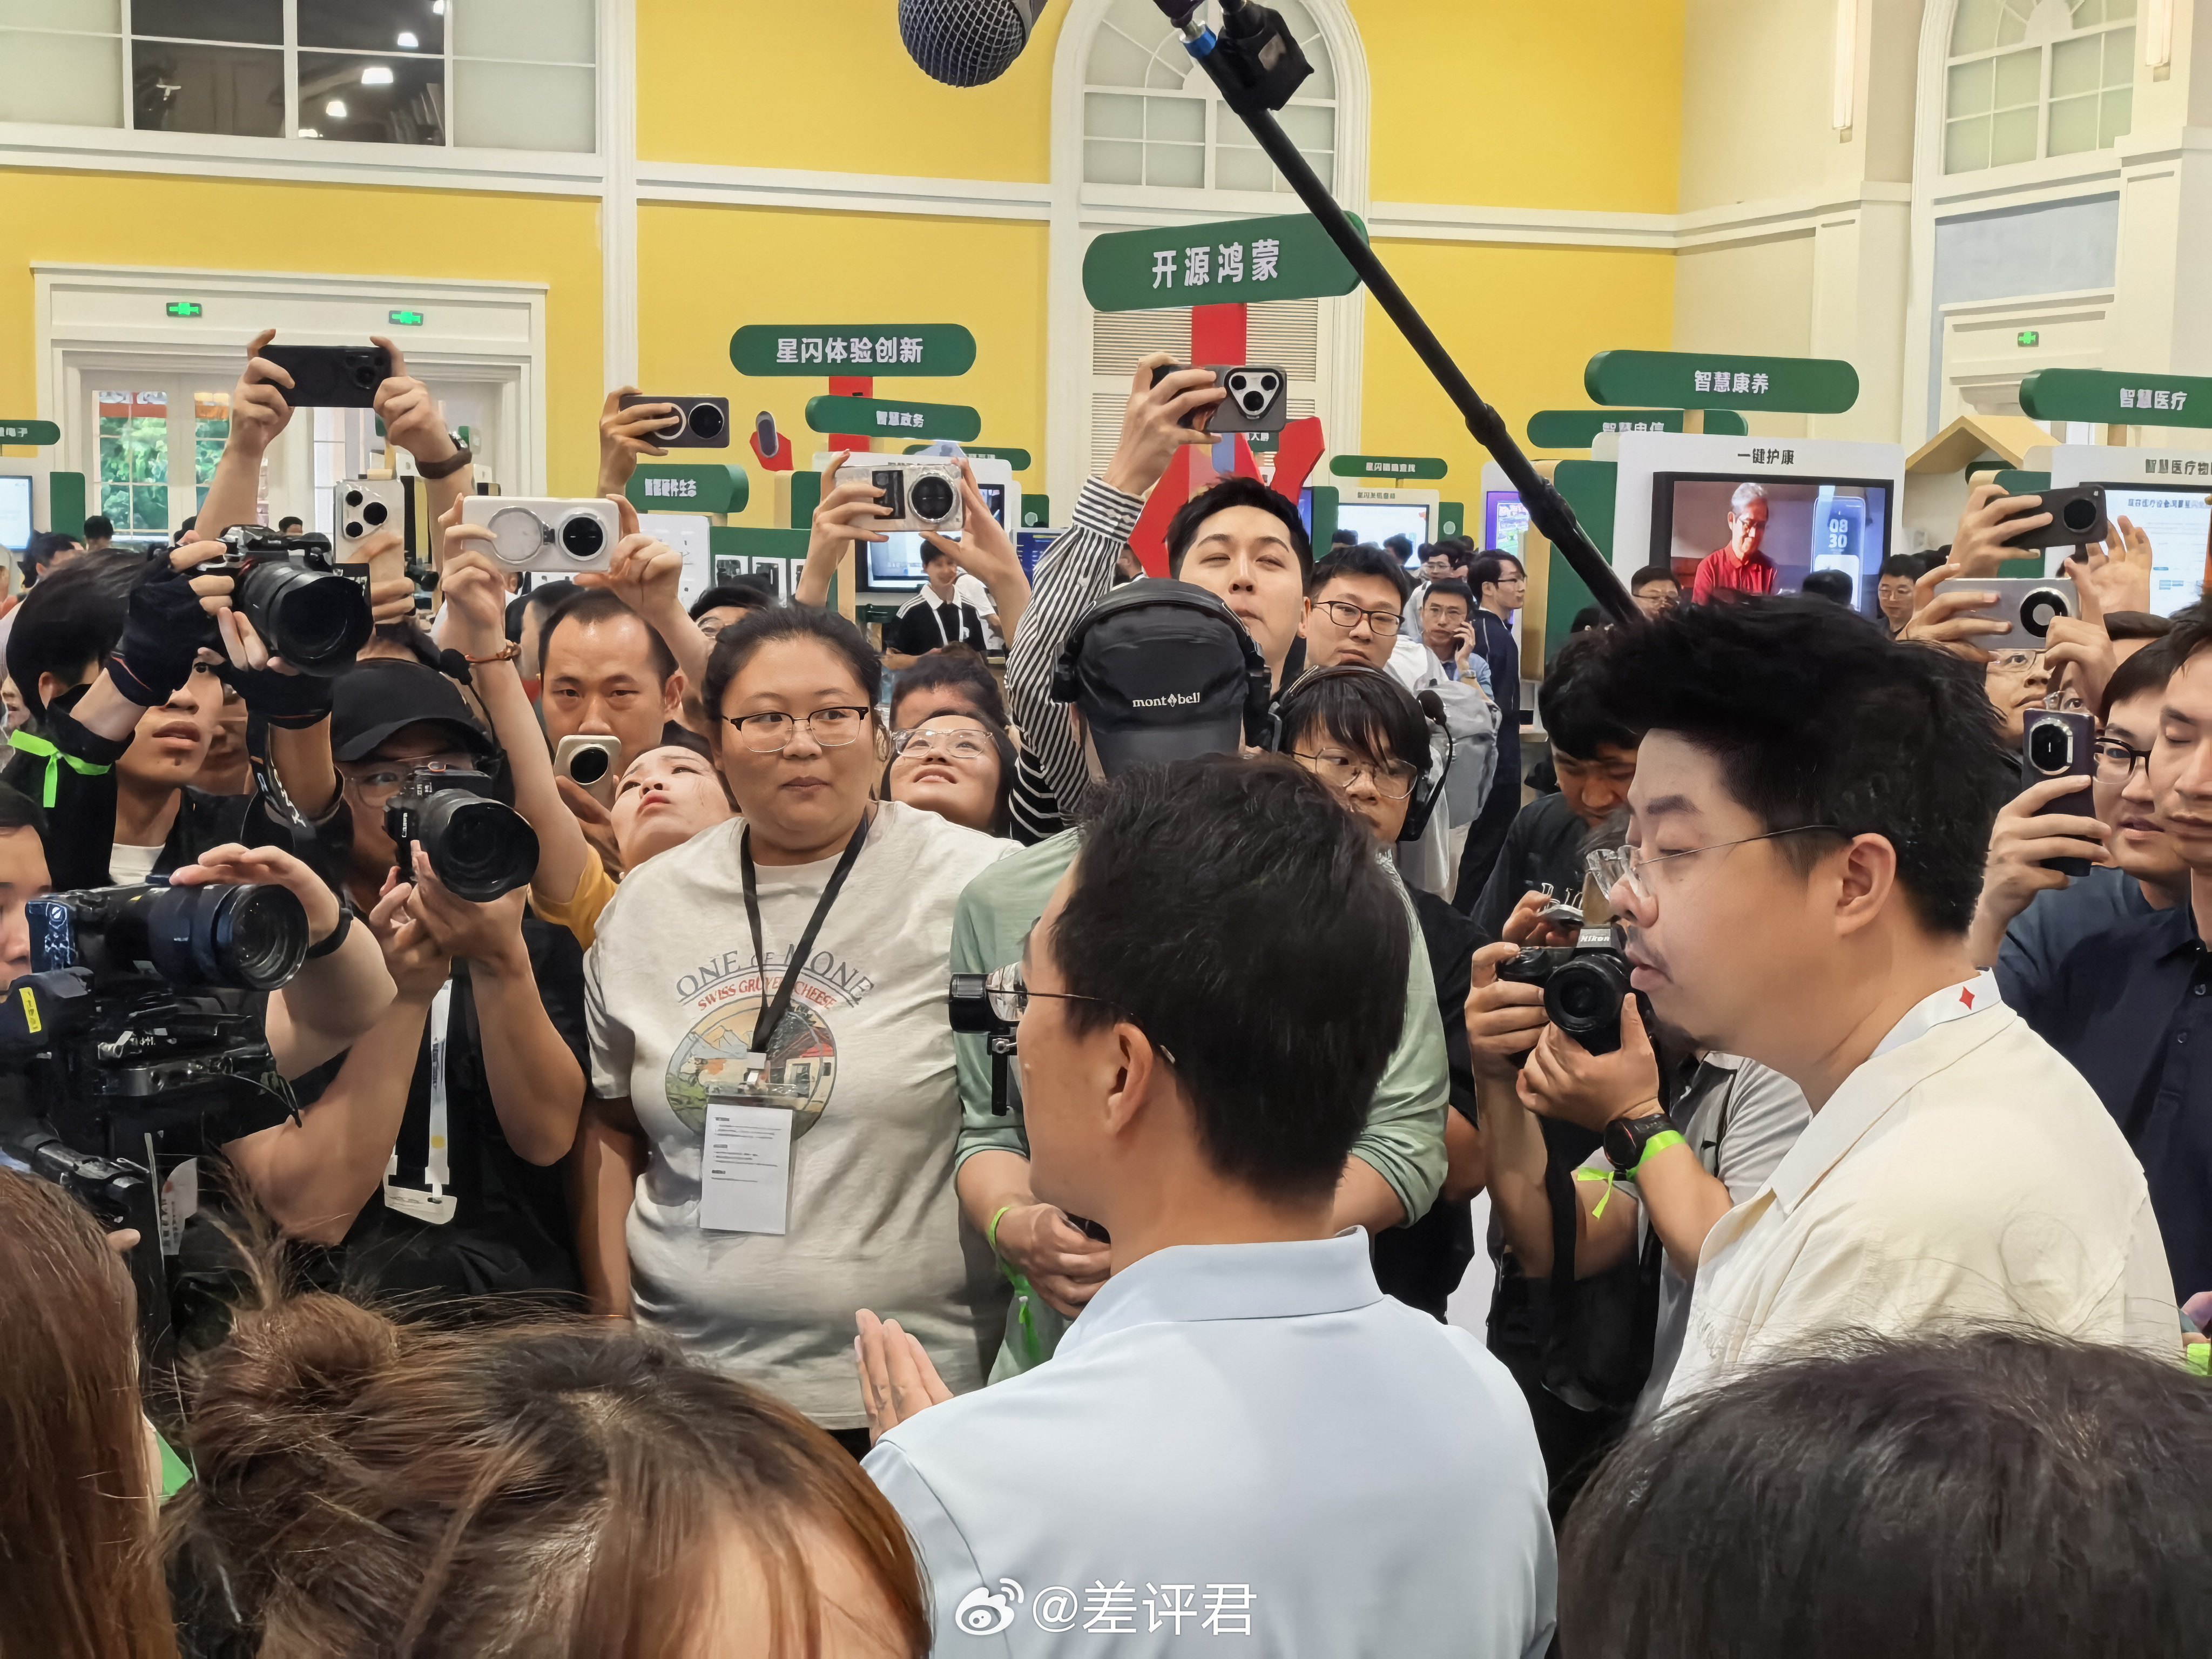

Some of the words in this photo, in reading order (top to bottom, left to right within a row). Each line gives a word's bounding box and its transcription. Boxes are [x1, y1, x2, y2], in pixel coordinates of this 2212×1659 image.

[1152, 239, 1279, 289] 开源鸿蒙
[776, 337, 923, 363] 星闪体验创新
[1695, 370, 1769, 394] 智慧康养
[2120, 388, 2188, 410] 智慧医疗
[1737, 448, 1794, 464] 一键护康
[1829, 518, 1848, 532] 08
[1828, 534, 1847, 548] 30
[676, 950, 740, 996] ONE
[698, 983, 736, 1011] SWISS
[794, 980, 838, 1009] CHEESE
